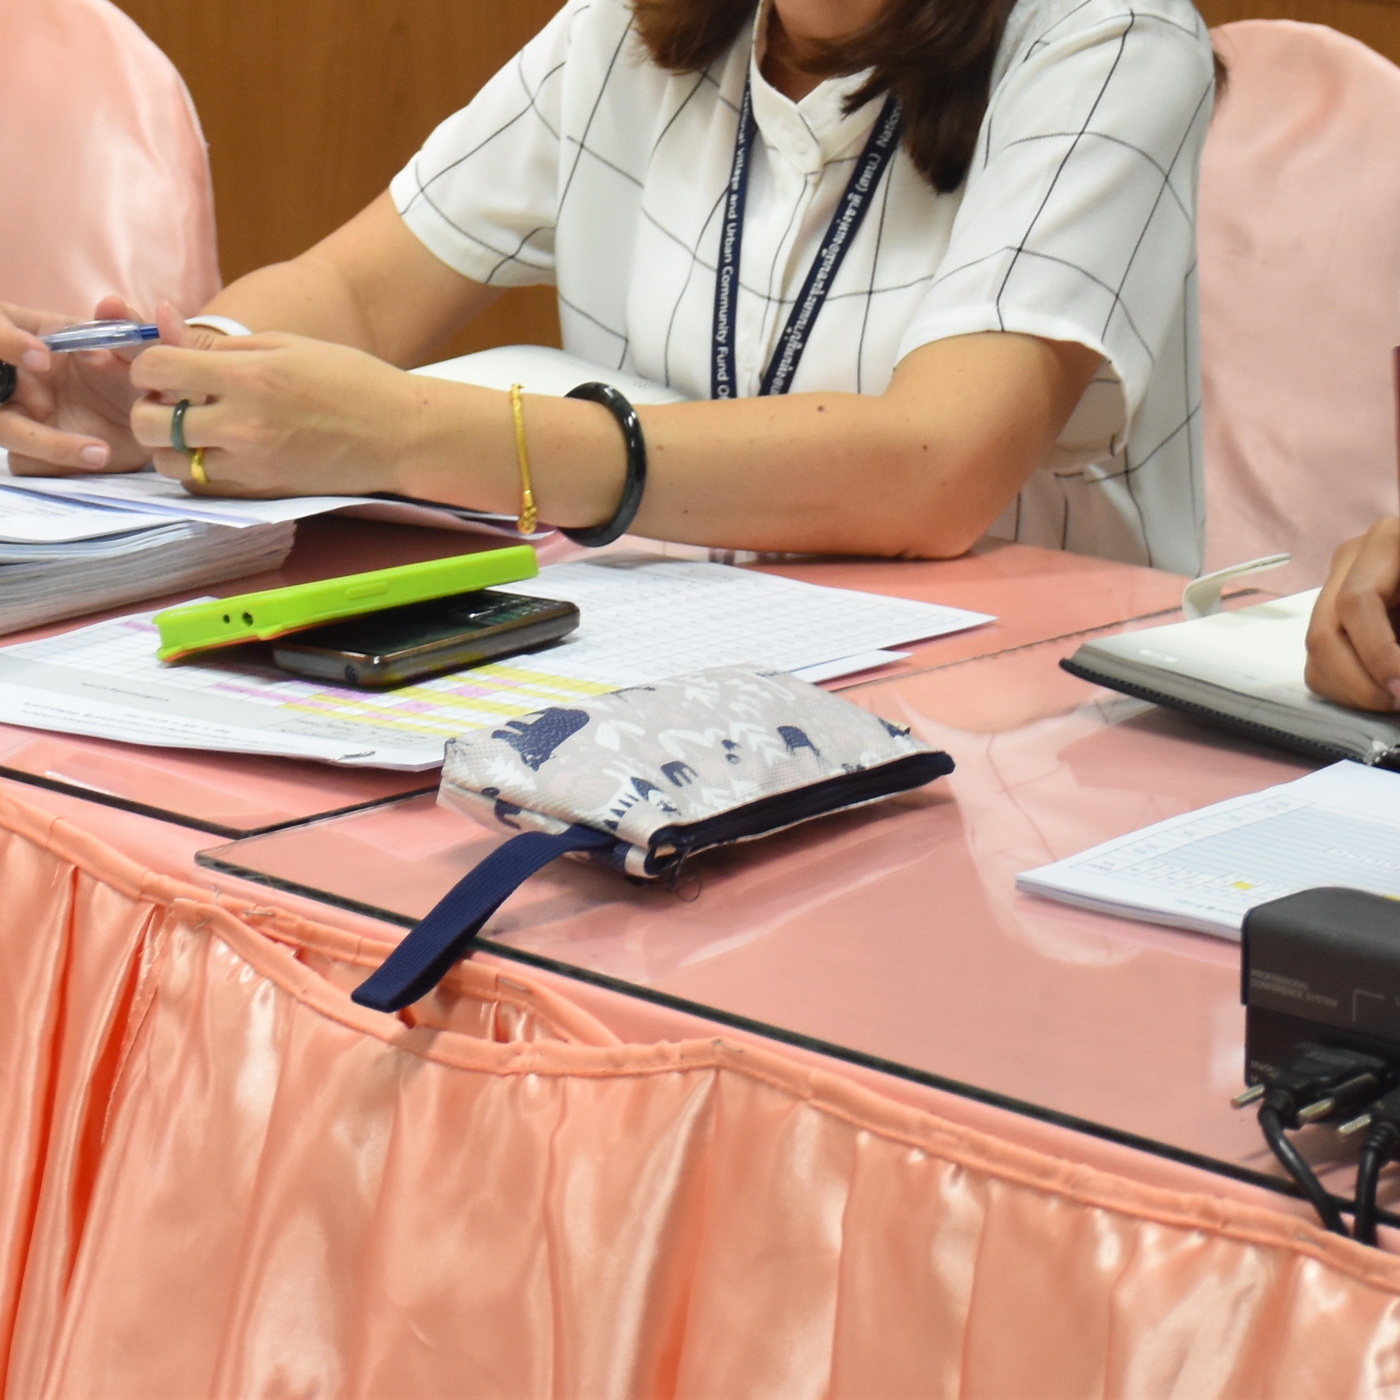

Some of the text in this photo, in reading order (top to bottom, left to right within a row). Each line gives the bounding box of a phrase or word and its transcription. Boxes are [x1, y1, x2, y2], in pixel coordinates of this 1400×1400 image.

[730, 147, 746, 191] Village
[727, 193, 739, 221] and
[723, 222, 738, 264] Urban
[715, 265, 734, 343] Community
[716, 346, 729, 382] Fund
